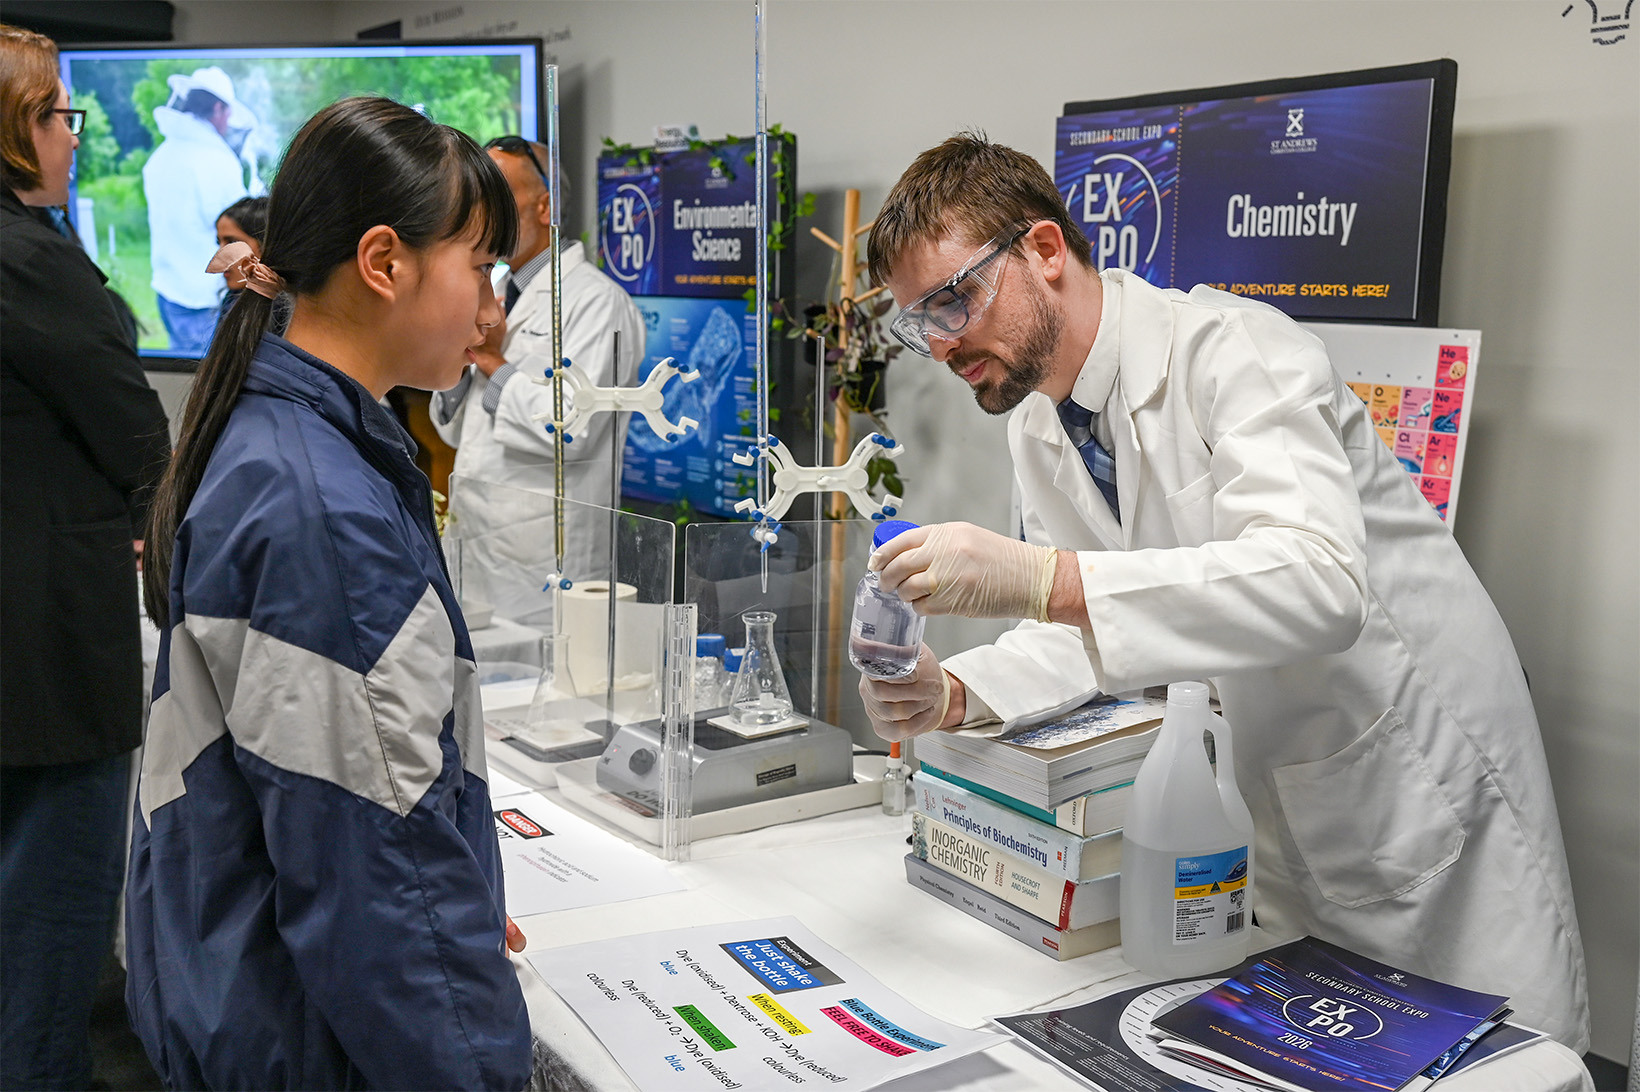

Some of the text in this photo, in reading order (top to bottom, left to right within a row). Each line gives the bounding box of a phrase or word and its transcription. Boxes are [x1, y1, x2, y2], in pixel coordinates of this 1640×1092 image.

[1070, 124, 1162, 146] SECONDARY SCHOOL EXPO
[1227, 191, 1357, 246] Chemistry
[692, 230, 741, 261] Science
[1230, 283, 1296, 296] ADVENTURE
[1300, 283, 1349, 297] STARTS
[1352, 284, 1390, 298] HERE!
[1441, 348, 1456, 359] He
[1374, 387, 1384, 397] O
[1404, 389, 1412, 399] F
[1436, 392, 1450, 403] Ne
[1398, 433, 1410, 443] Cl
[1429, 436, 1441, 446] Ar
[1423, 479, 1434, 489] Kr
[941, 794, 967, 811] Lehninger
[496, 826, 514, 839] OT
[504, 814, 538, 834] DANGER
[931, 828, 991, 867] INORGANIC
[943, 807, 1048, 868] Principles of Biochemistry
[931, 844, 987, 882] CHEMISTRY
[1178, 868, 1212, 878] Demineralised
[1011, 872, 1041, 890] HOUSECROFT
[1011, 882, 1039, 900] AND SHARPE
[919, 875, 935, 889] Physical
[935, 883, 955, 898] Chemistry
[976, 904, 987, 914] Reid
[994, 913, 1005, 924] Third
[1005, 918, 1021, 931] Edition
[1060, 892, 1069, 918] PEARSON
[736, 944, 789, 987] the bottle
[754, 941, 813, 986] Just shake
[777, 939, 813, 967] Experiment
[586, 972, 621, 1002] colourless
[1305, 971, 1430, 1020] SECONDARY SCHOOL EXPO
[659, 960, 806, 1084] blue colourless
[676, 949, 693, 963] Dye
[687, 961, 725, 991] (oxidised)
[723, 994, 758, 1023] Dextrose
[759, 1026, 784, 1043] KOH
[784, 1048, 805, 1062] Dye
[801, 1059, 848, 1084] (reduced)
[678, 1005, 702, 1025] When
[752, 993, 804, 1036] When resting:
[824, 1006, 848, 1021] FEEL
[843, 1020, 869, 1036] FREE
[865, 1034, 882, 1047] TO
[842, 998, 864, 1013] Blue
[861, 1012, 889, 1030] Bottle
[621, 979, 639, 992] Dye
[630, 990, 672, 1021] (reduced)
[686, 1043, 704, 1059] Dye
[696, 1057, 743, 1091] (oxidised)
[1277, 1032, 1313, 1050] 2026
[664, 1054, 686, 1073] blue
[1208, 1024, 1346, 1082] YOUR ADVENTURE STARTS HERE!
